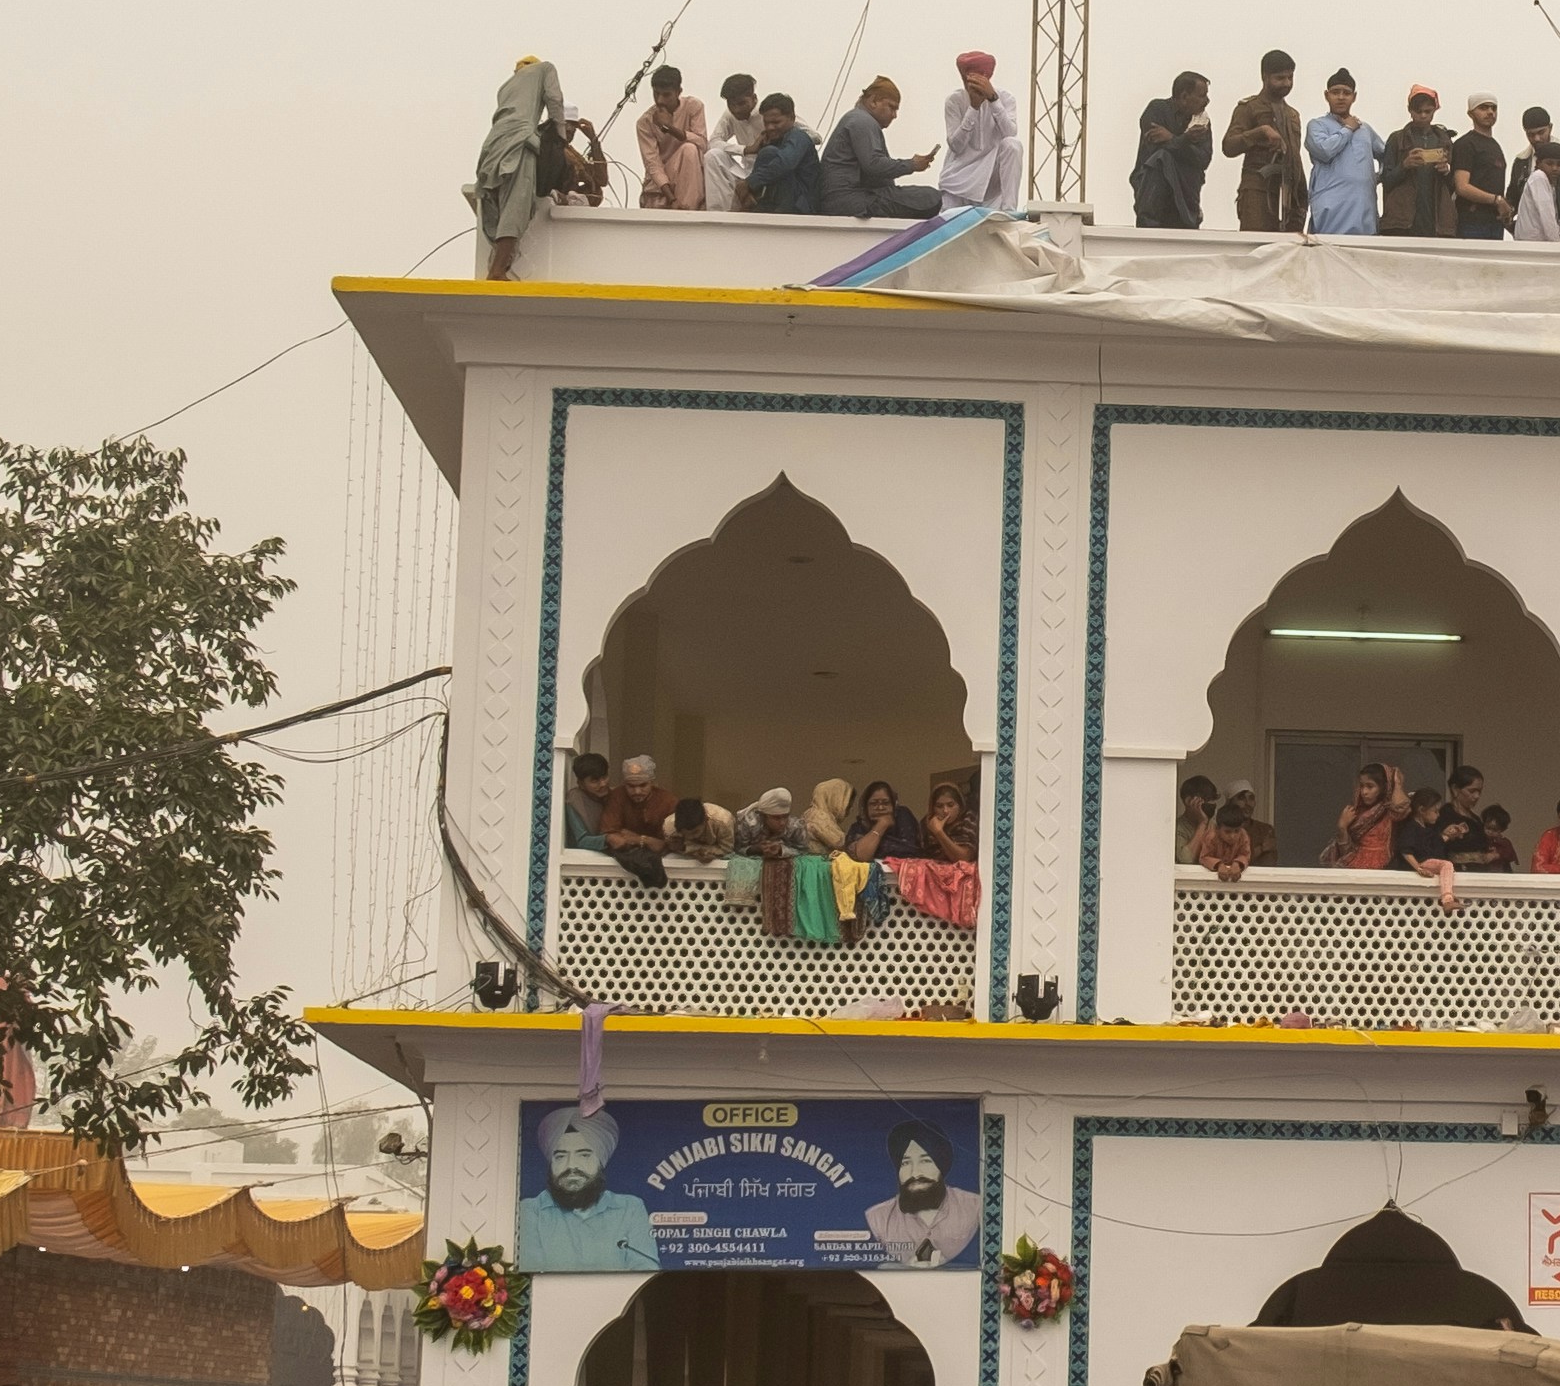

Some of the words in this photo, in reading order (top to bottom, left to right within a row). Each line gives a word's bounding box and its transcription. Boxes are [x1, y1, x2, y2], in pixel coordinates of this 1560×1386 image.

[712, 1107, 789, 1123] OFFICE
[646, 1134, 726, 1191] PUNJABI
[729, 1132, 777, 1154] SIKH
[780, 1136, 854, 1189] SANGAT
[683, 1177, 734, 1198] ਪੰਜਾਬੀ
[739, 1177, 770, 1198] ਸਿੱਖ
[776, 1178, 817, 1198] ਸੰਗਤ
[653, 1214, 705, 1223] Chairman
[649, 1228, 689, 1238] GOPAL
[693, 1228, 731, 1238] SINGH
[734, 1227, 788, 1238] CHAWLA
